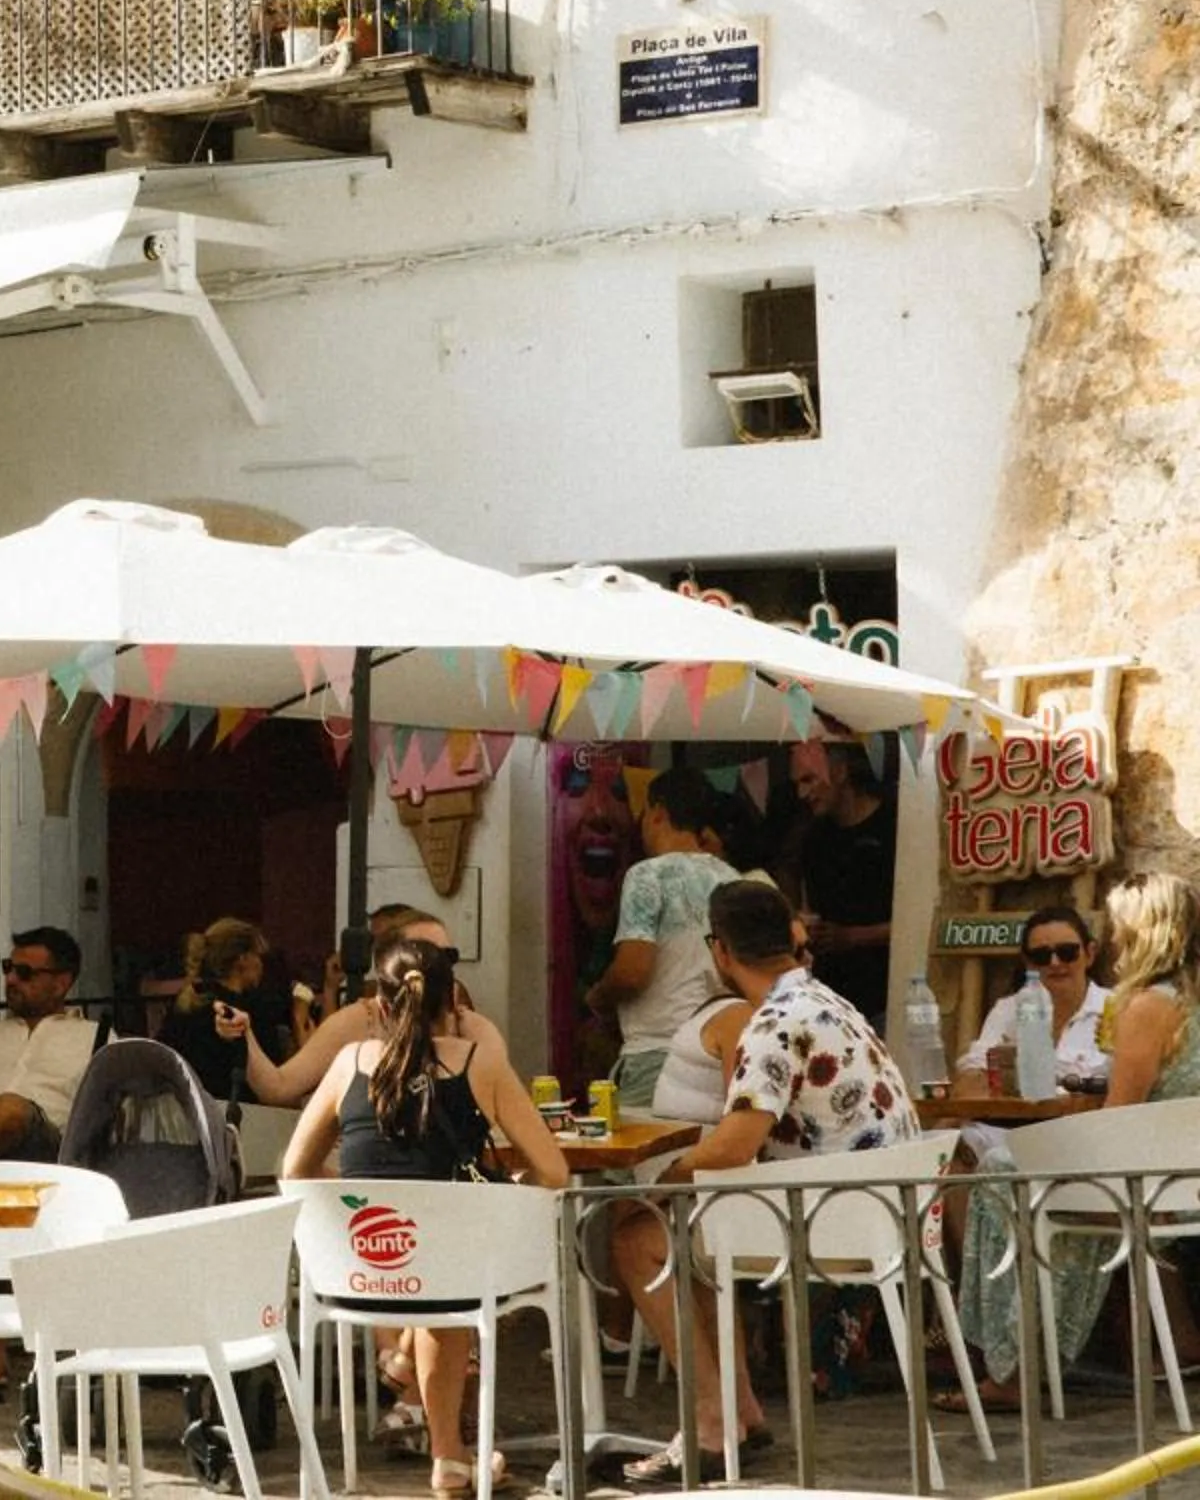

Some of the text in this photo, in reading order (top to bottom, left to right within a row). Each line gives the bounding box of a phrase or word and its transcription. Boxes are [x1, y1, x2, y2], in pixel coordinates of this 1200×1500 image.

[631, 27, 748, 54] Plaça de Vila
[945, 784, 1092, 869] teria
[945, 918, 1008, 945] home
